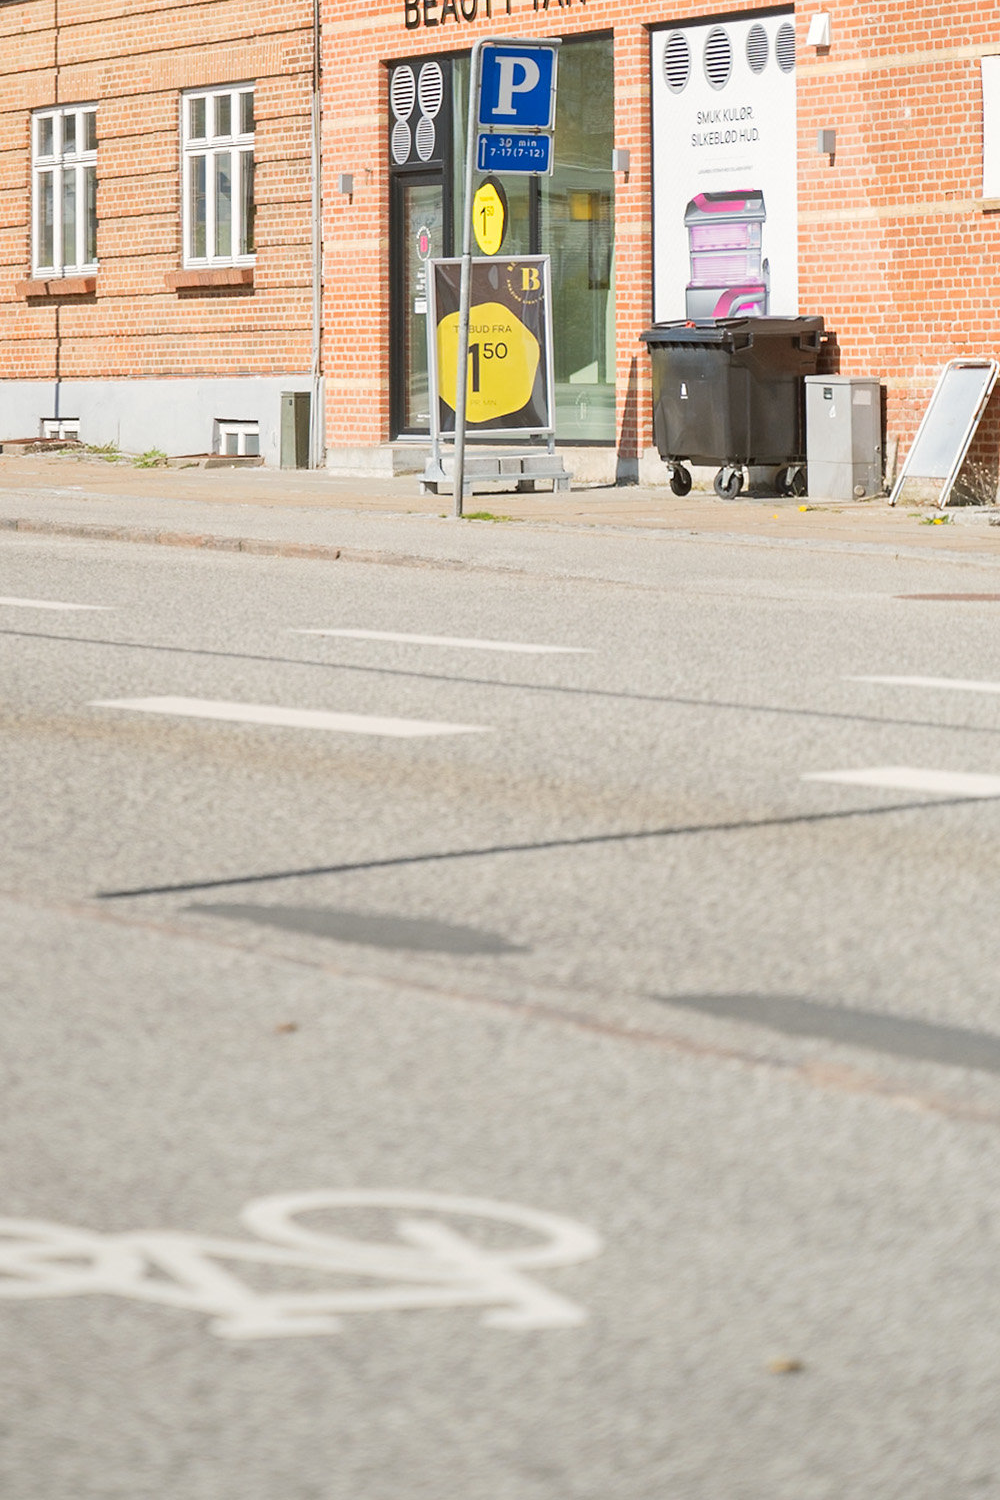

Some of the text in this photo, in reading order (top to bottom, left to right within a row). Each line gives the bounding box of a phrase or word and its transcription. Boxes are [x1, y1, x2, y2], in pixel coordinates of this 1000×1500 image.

[491, 55, 541, 115] P
[697, 109, 721, 125] SMUK
[499, 138, 538, 148] 30 min
[691, 129, 738, 147] SILKEBLØD
[521, 267, 541, 291] B
[453, 324, 513, 334] TBUD FRA
